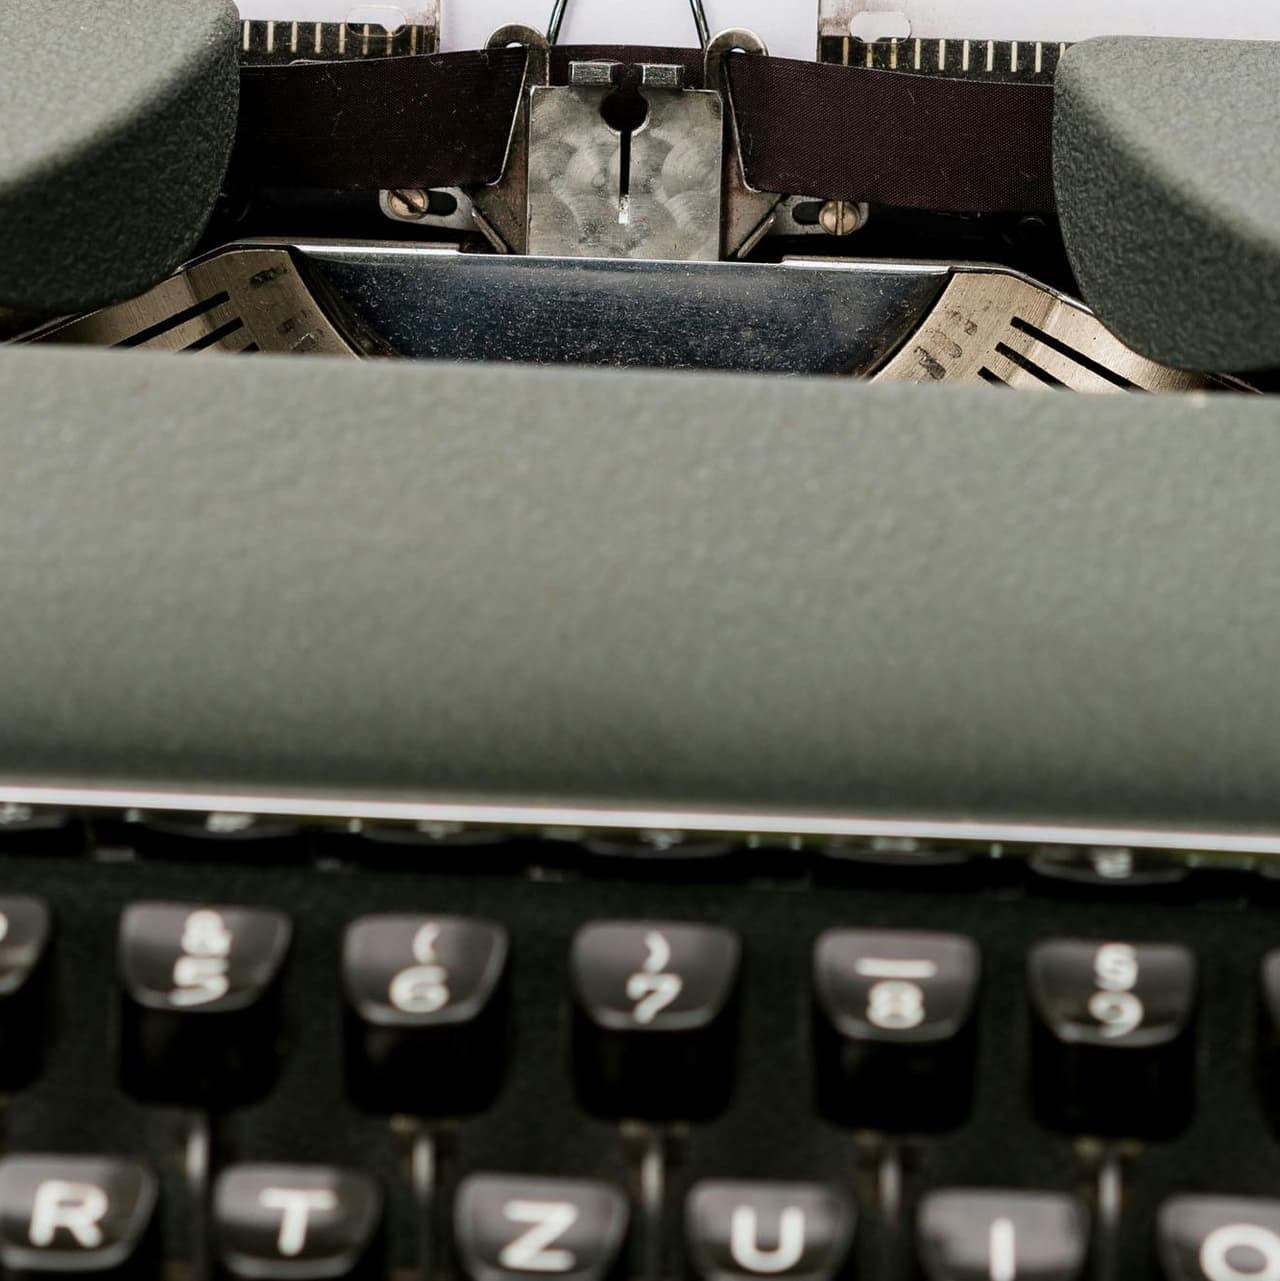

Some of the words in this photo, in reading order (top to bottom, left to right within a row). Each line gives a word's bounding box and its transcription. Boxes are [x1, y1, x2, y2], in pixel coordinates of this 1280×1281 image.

[170, 956, 230, 1006] 5
[389, 964, 449, 1013] 6
[626, 972, 683, 1024] 7
[867, 980, 926, 1030] 8
[1088, 991, 1144, 1039] 9
[28, 1179, 108, 1248] R
[259, 1187, 338, 1256] T
[499, 1199, 580, 1271] Z
[729, 1204, 806, 1273] U
[988, 1217, 1017, 1281] I
